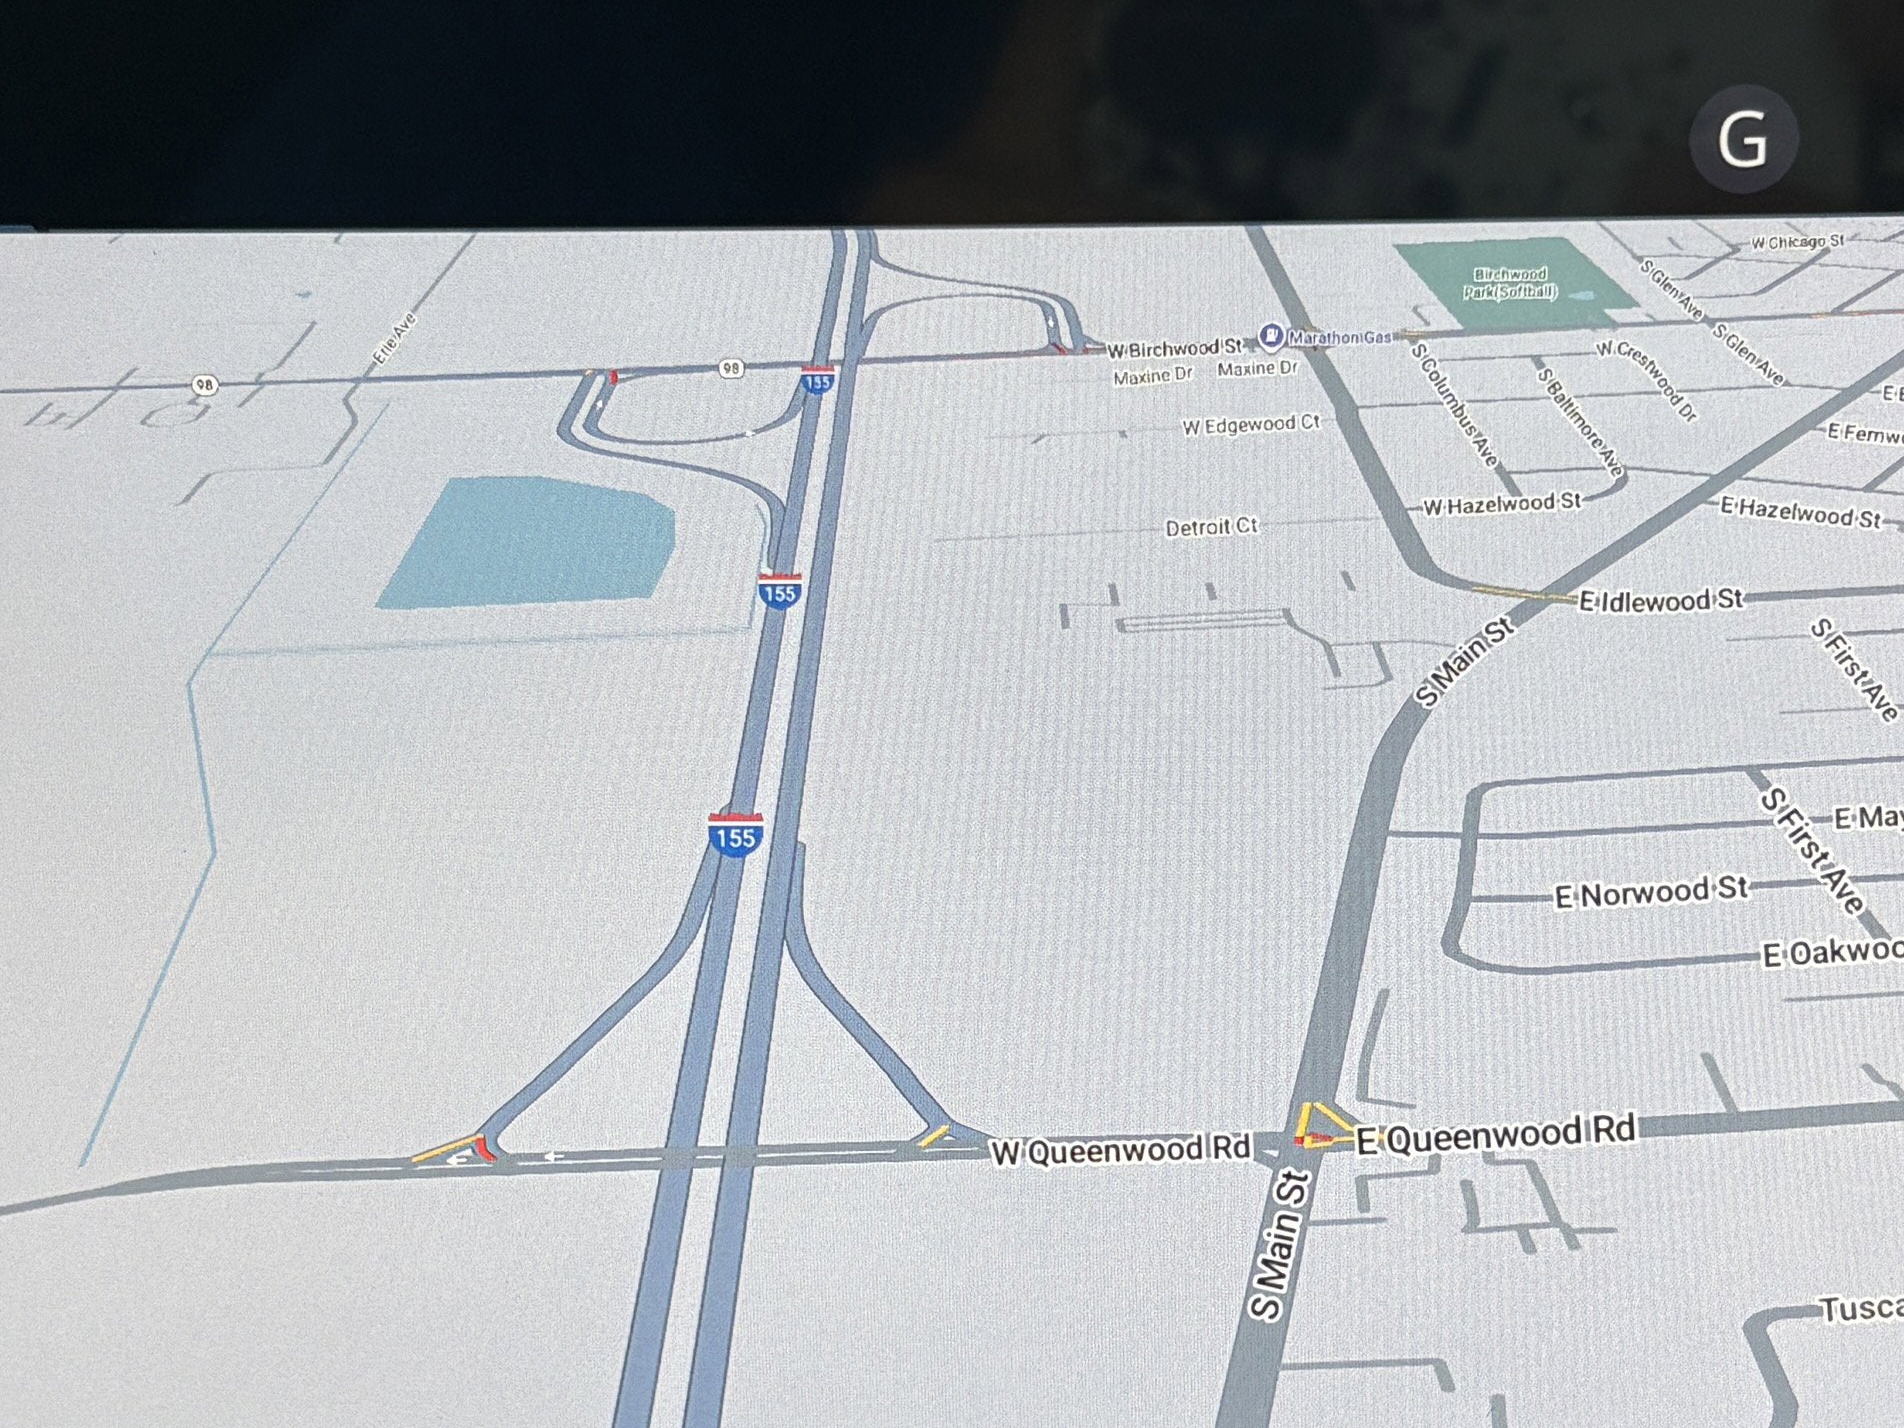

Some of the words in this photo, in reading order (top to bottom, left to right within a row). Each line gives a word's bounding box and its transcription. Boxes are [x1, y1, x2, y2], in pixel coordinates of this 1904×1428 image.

[1719, 110, 1767, 168] G
[1108, 345, 1124, 358] W
[1130, 338, 1219, 357] Birchwood
[1225, 338, 1242, 353] St
[1714, 324, 1725, 338] S
[1726, 334, 1756, 364] Glen
[1757, 362, 1784, 387] Ave
[724, 362, 740, 376] 98
[1218, 363, 1275, 376] Maxine
[1280, 361, 1297, 373] Dr
[1597, 340, 1614, 357] W
[1617, 342, 1682, 408] Crestwood
[1678, 403, 1697, 424] Dr
[197, 378, 214, 392] 98
[1413, 344, 1426, 358] S
[1422, 359, 1478, 437] Columbus
[1472, 436, 1496, 467] Ave
[1183, 422, 1199, 435] W
[1206, 415, 1296, 436] Edgewood
[1302, 414, 1320, 429] Ct
[1424, 500, 1445, 516] W
[1448, 496, 1554, 514] Hazelwood
[1562, 493, 1582, 510] St
[1721, 497, 1735, 513] E
[1740, 499, 1852, 526] Hazelwood
[1860, 511, 1881, 529] St
[1167, 519, 1230, 536] Detroit
[1236, 518, 1258, 533] Ct
[765, 586, 795, 602] 155
[1580, 591, 1594, 610] E
[1602, 589, 1711, 612] Idlewood
[1719, 589, 1743, 606] St
[1417, 687, 1438, 706] S
[1432, 642, 1488, 691] Main
[1485, 618, 1513, 643] St
[1812, 620, 1831, 638] S
[1826, 636, 1867, 684] First
[1862, 682, 1898, 723] Ave
[1835, 808, 1850, 828] E
[717, 830, 755, 847] 155
[1762, 788, 1782, 810] S
[1777, 808, 1827, 866] First
[1821, 868, 1862, 916] Ave
[1556, 887, 1572, 907] E
[1582, 878, 1708, 906] Norwood
[1718, 877, 1748, 898] St
[1764, 944, 1782, 967] E
[1356, 1128, 1376, 1154] E
[1388, 1117, 1582, 1154] Queenwood
[1595, 1114, 1635, 1141] Rd
[992, 1142, 1018, 1164] W
[1028, 1137, 1202, 1166] Queenwood
[1214, 1135, 1250, 1158] Rd
[1276, 1171, 1310, 1206] St
[1257, 1217, 1296, 1292] Main
[1250, 1296, 1280, 1320] S
